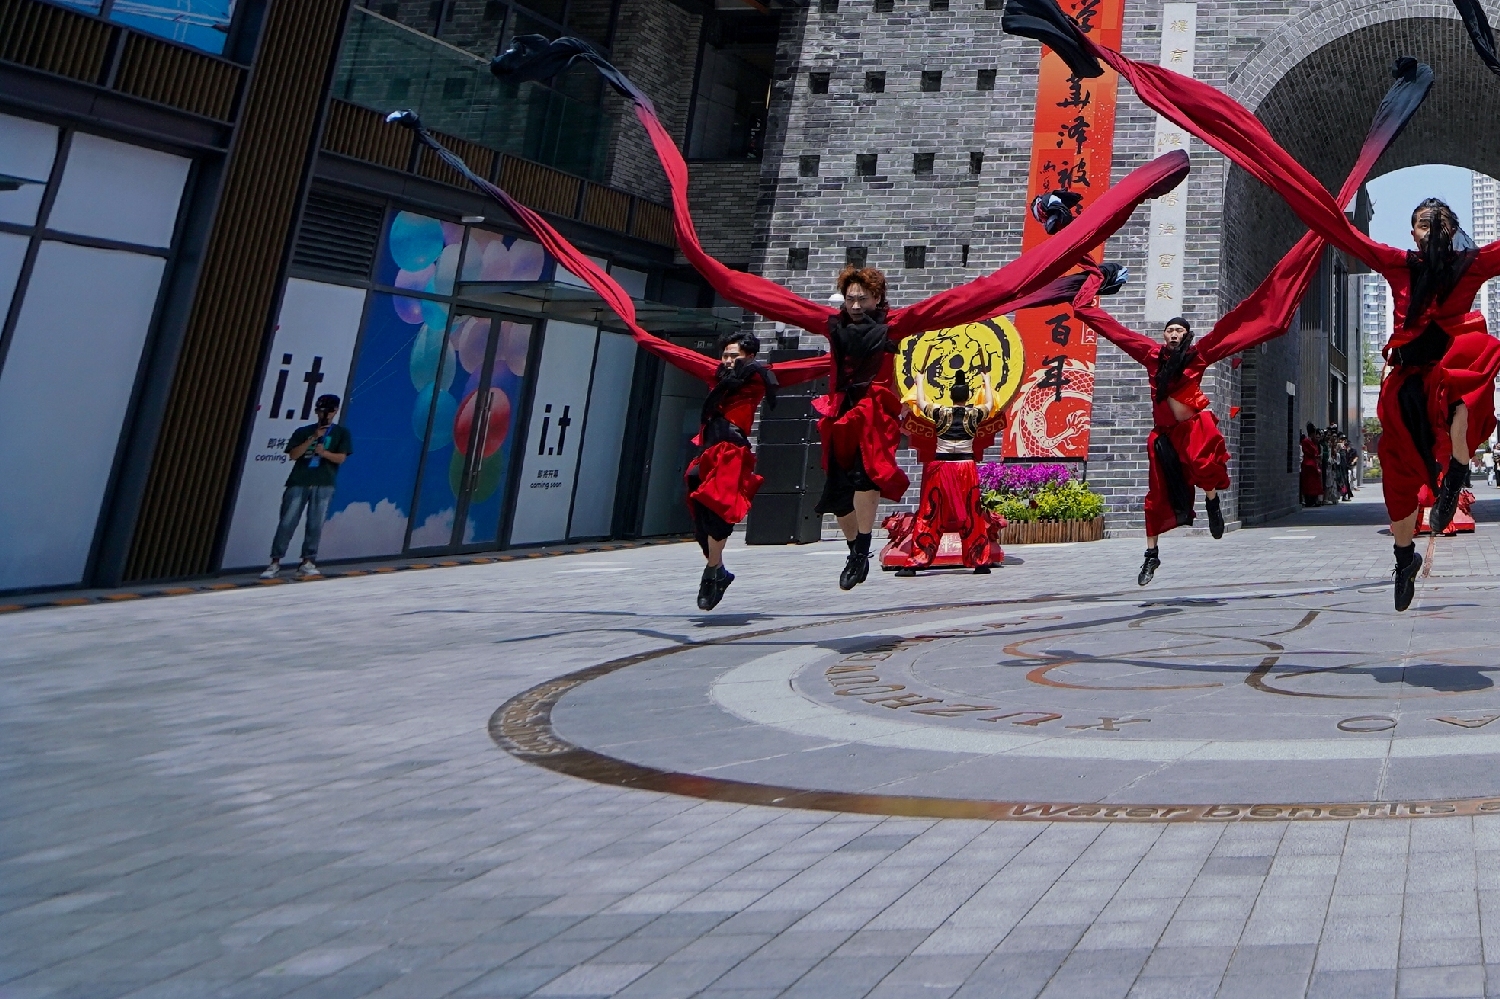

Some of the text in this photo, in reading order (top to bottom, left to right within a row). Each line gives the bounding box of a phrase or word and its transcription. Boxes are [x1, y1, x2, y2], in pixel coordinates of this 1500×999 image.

[538, 404, 571, 456] i.t
[255, 452, 287, 464] coming
[530, 481, 562, 490] coming soon
[1011, 803, 1188, 818] Water
[1202, 801, 1456, 818] benefits
